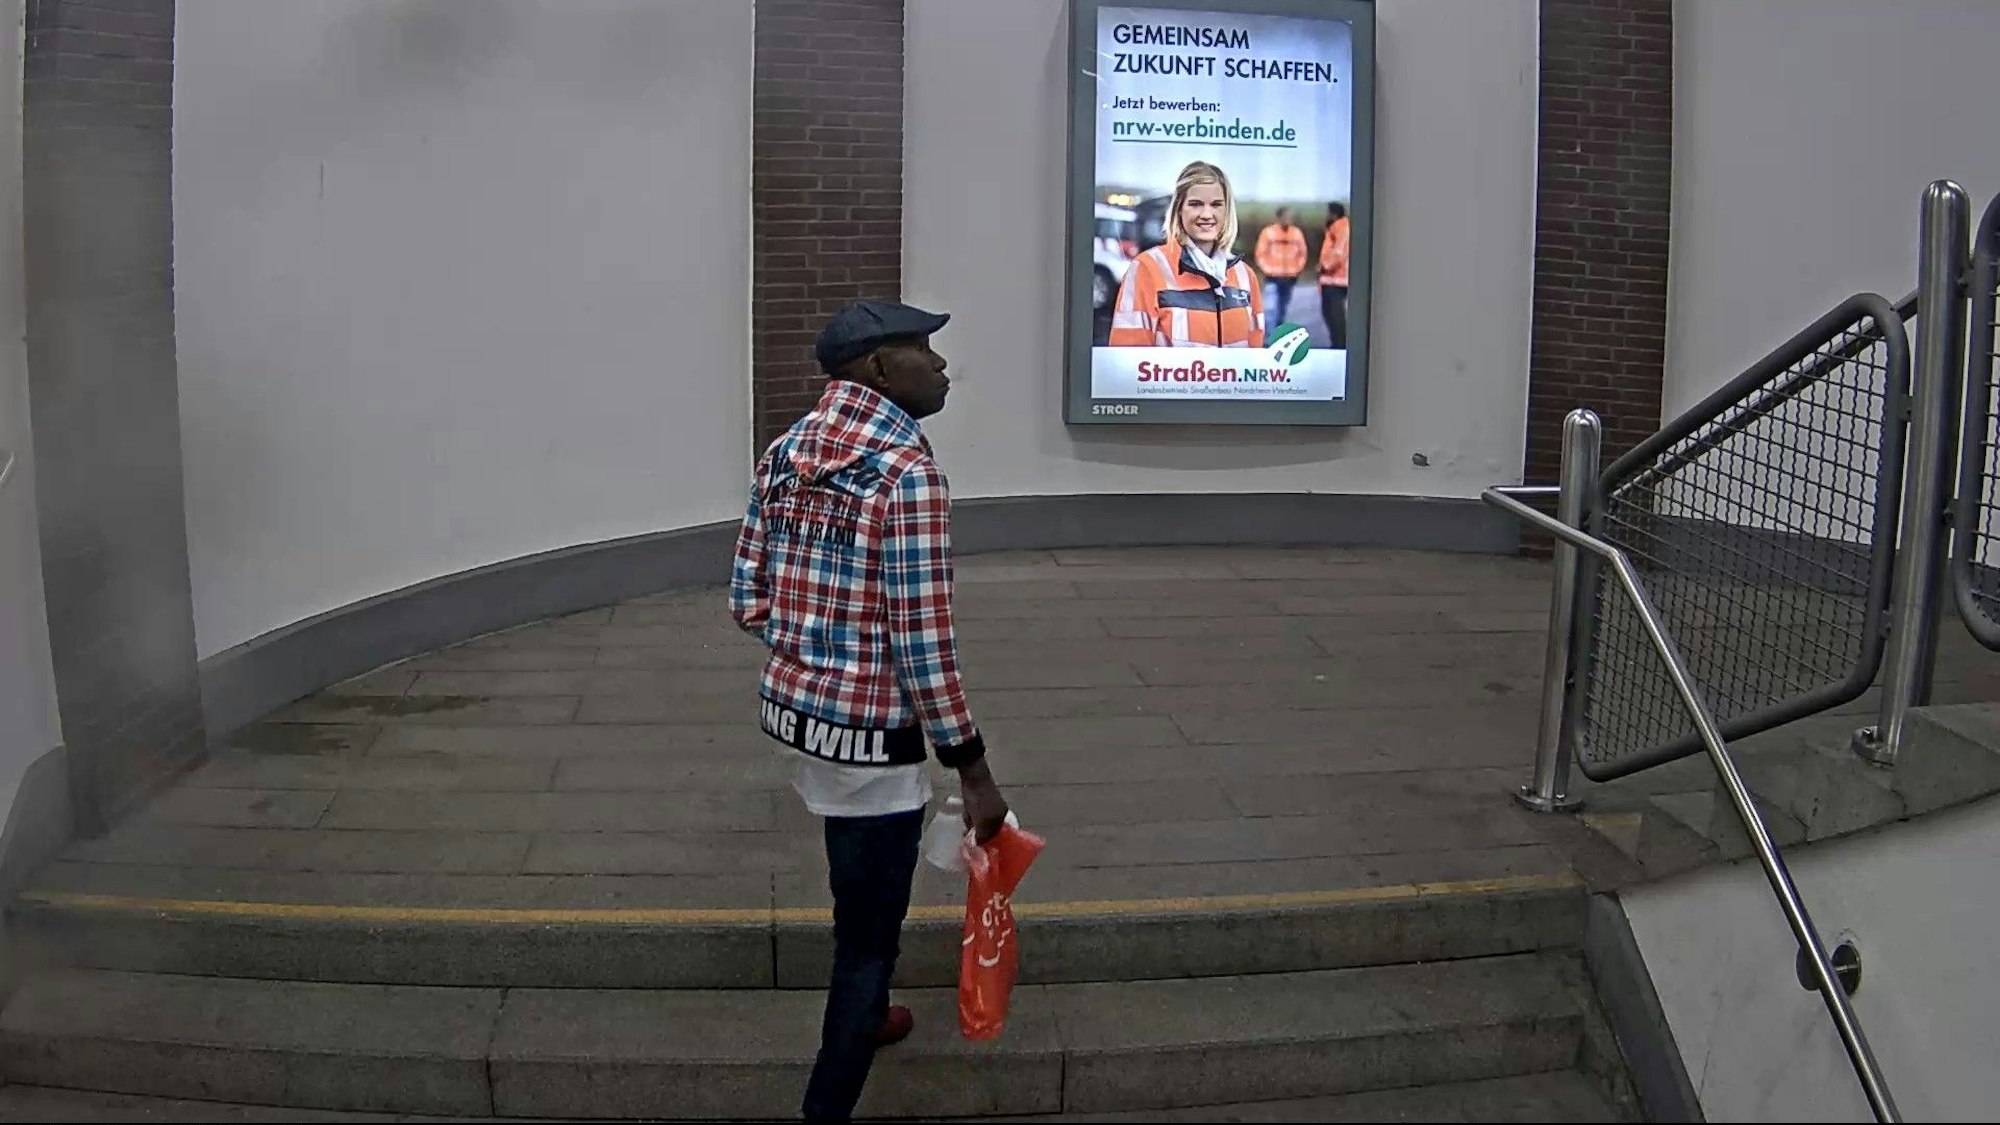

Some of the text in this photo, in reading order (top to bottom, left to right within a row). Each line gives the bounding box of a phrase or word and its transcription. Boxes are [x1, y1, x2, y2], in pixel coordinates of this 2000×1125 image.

[1113, 24, 1250, 49] GEMEINSAM
[1113, 53, 1338, 83] ZUKUNFT SCHAFFEN.
[1112, 96, 1221, 112] Jetzt bewerben:
[1113, 116, 1296, 140] nrw-verbinden.de
[804, 717, 889, 762] WILL
